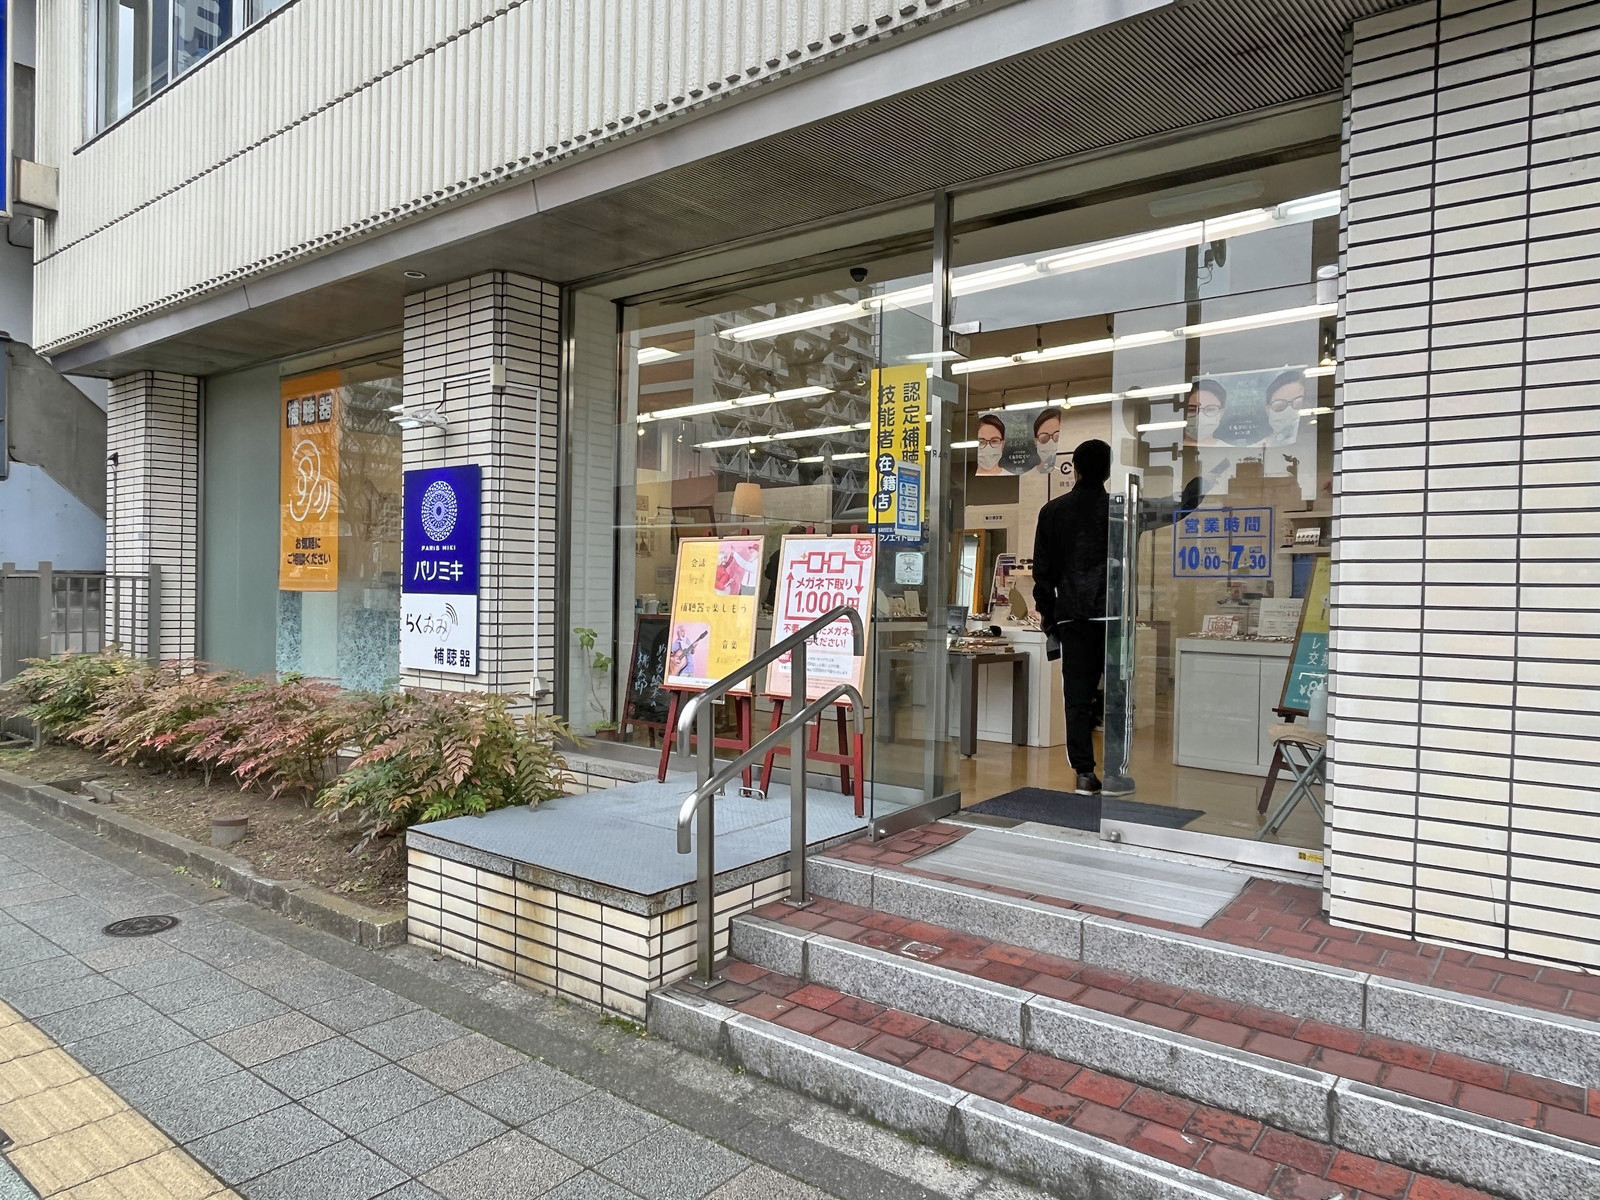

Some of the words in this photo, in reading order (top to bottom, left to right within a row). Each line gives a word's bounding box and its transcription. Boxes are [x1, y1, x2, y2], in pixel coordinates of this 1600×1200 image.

[1185, 516, 1261, 534] 営業時間
[413, 560, 464, 581] パリミキ
[795, 577, 853, 590] メガネ下取り
[434, 647, 470, 667] 補聴器
